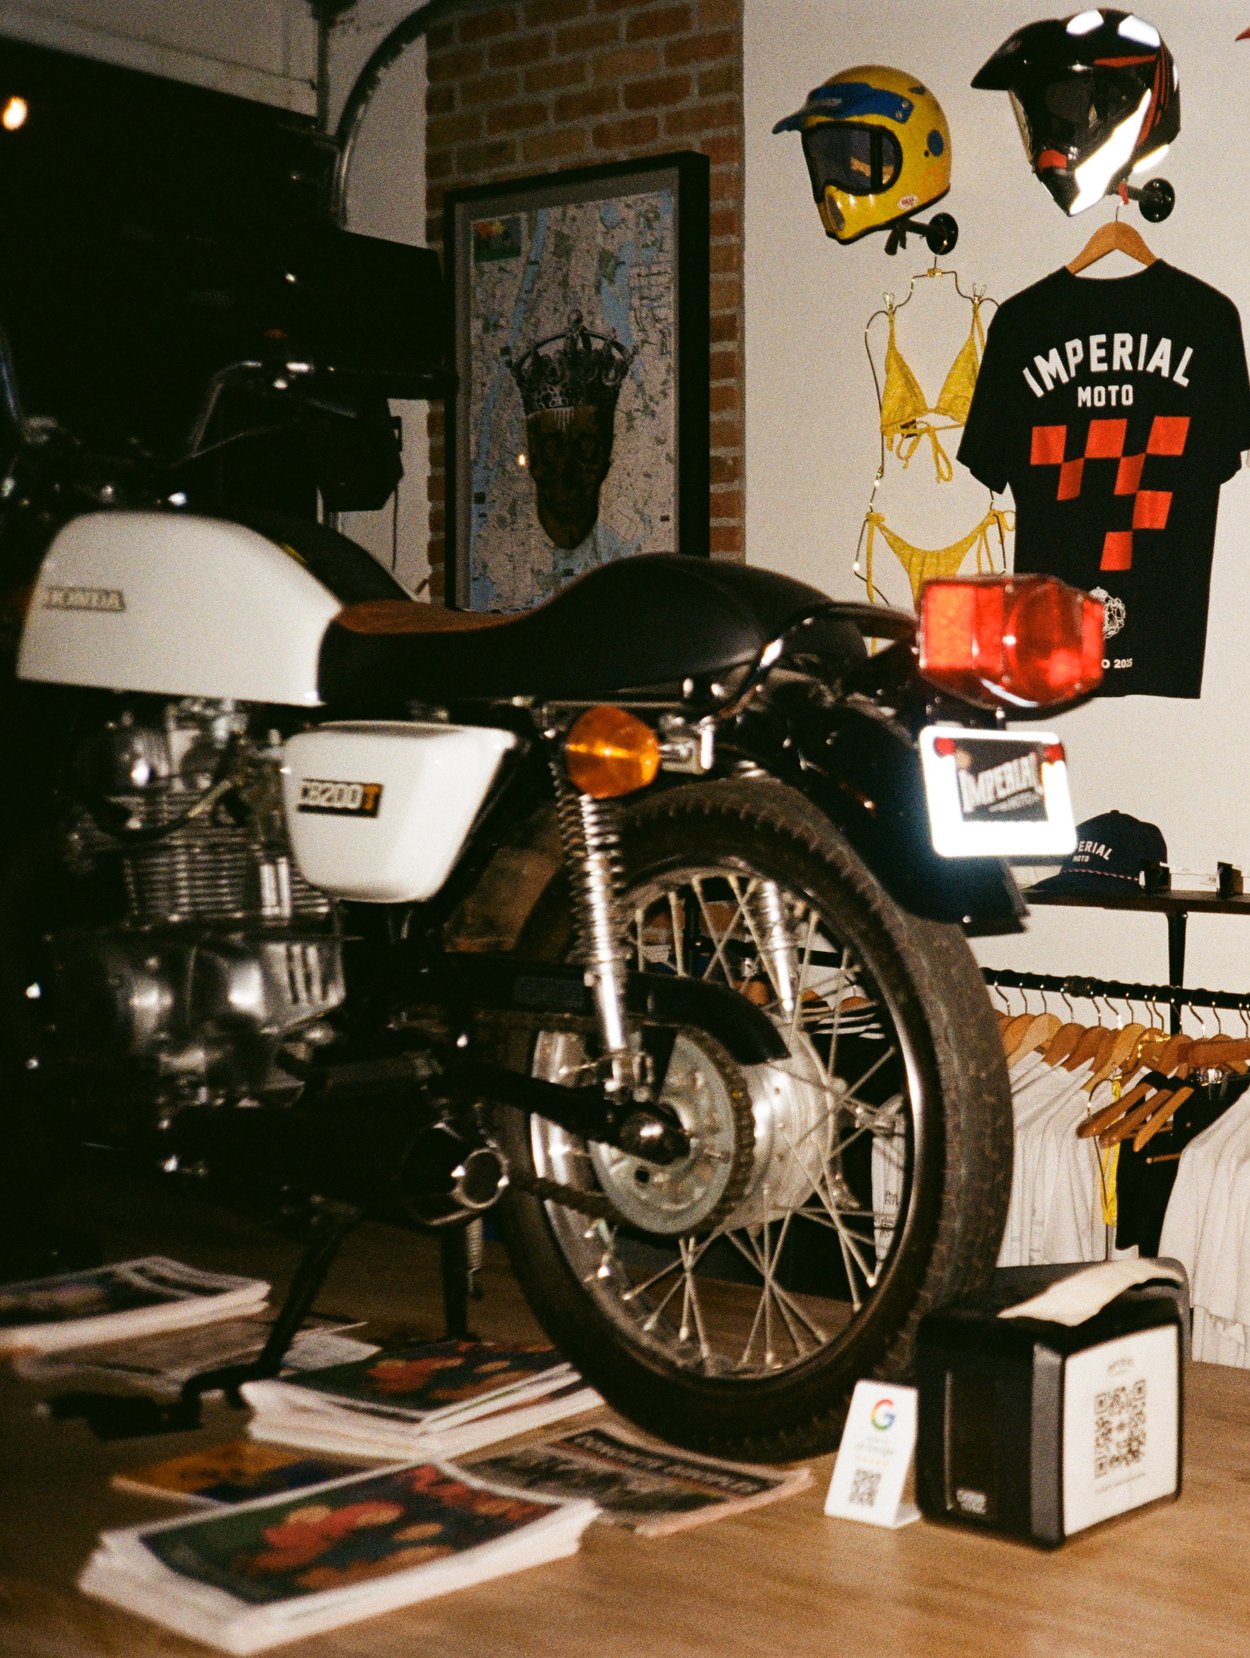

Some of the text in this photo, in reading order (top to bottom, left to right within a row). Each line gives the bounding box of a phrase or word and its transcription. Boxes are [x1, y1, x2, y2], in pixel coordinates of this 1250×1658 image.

[1022, 333, 1194, 398] IMPERIAL
[1077, 384, 1134, 408] MOTO
[958, 751, 1044, 813] IMPERIAL
[1078, 841, 1112, 861] ERIAL
